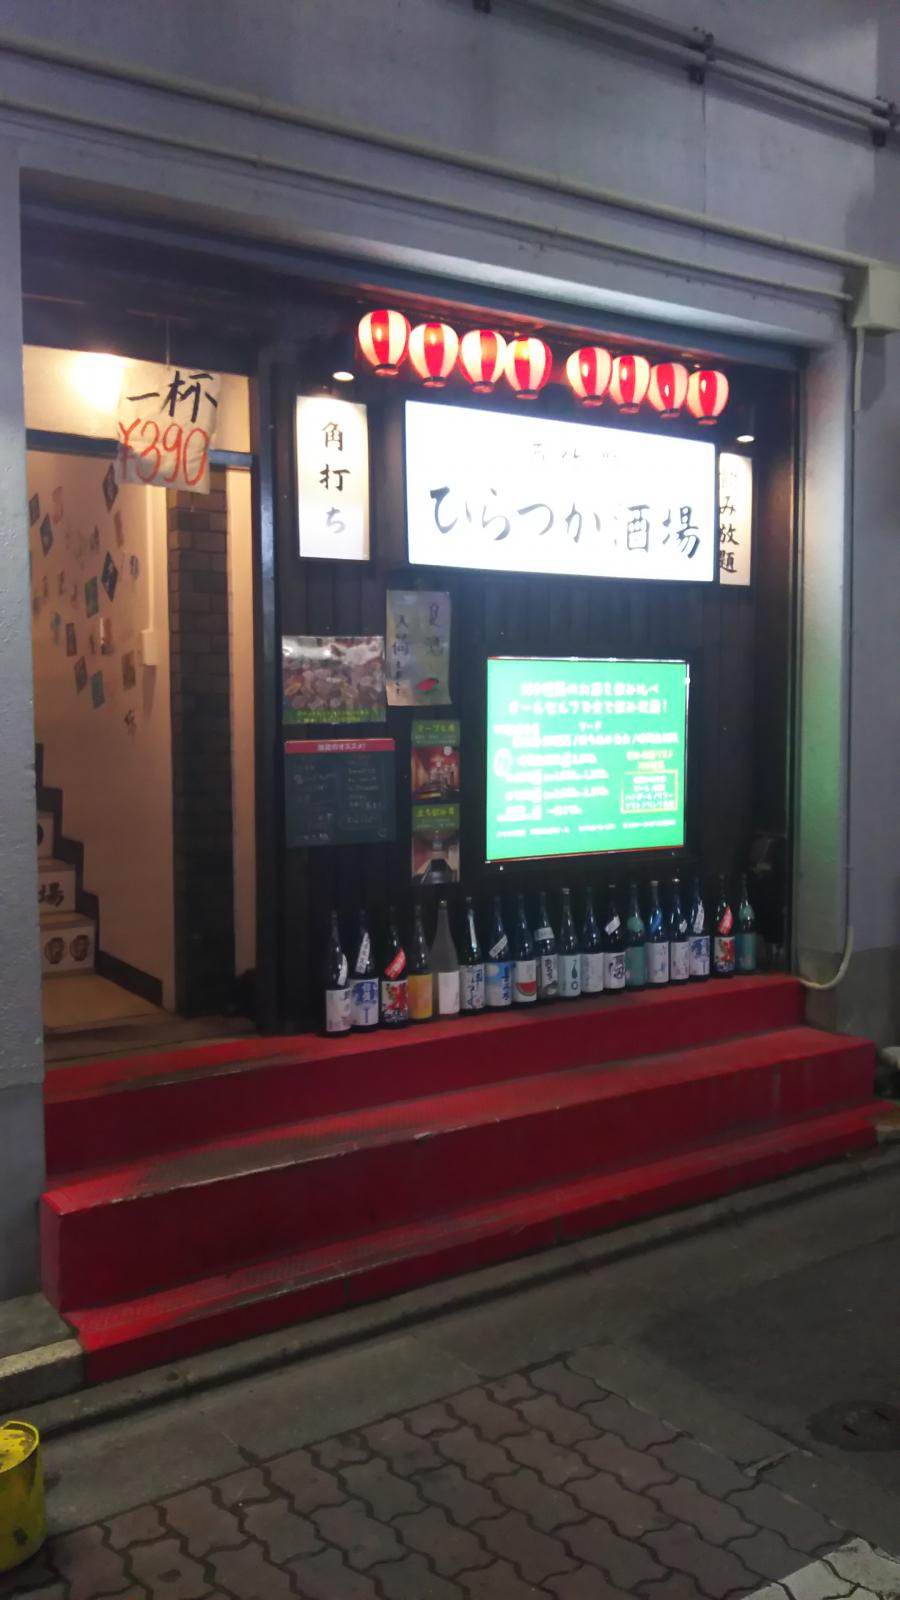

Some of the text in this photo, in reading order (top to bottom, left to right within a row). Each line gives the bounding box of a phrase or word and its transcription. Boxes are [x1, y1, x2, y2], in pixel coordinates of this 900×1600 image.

[126, 370, 218, 423] 一杯
[118, 418, 209, 486] ¥390
[319, 421, 351, 534] 角打ち
[430, 486, 701, 559] ひらつか酒場
[719, 472, 740, 573] み放題
